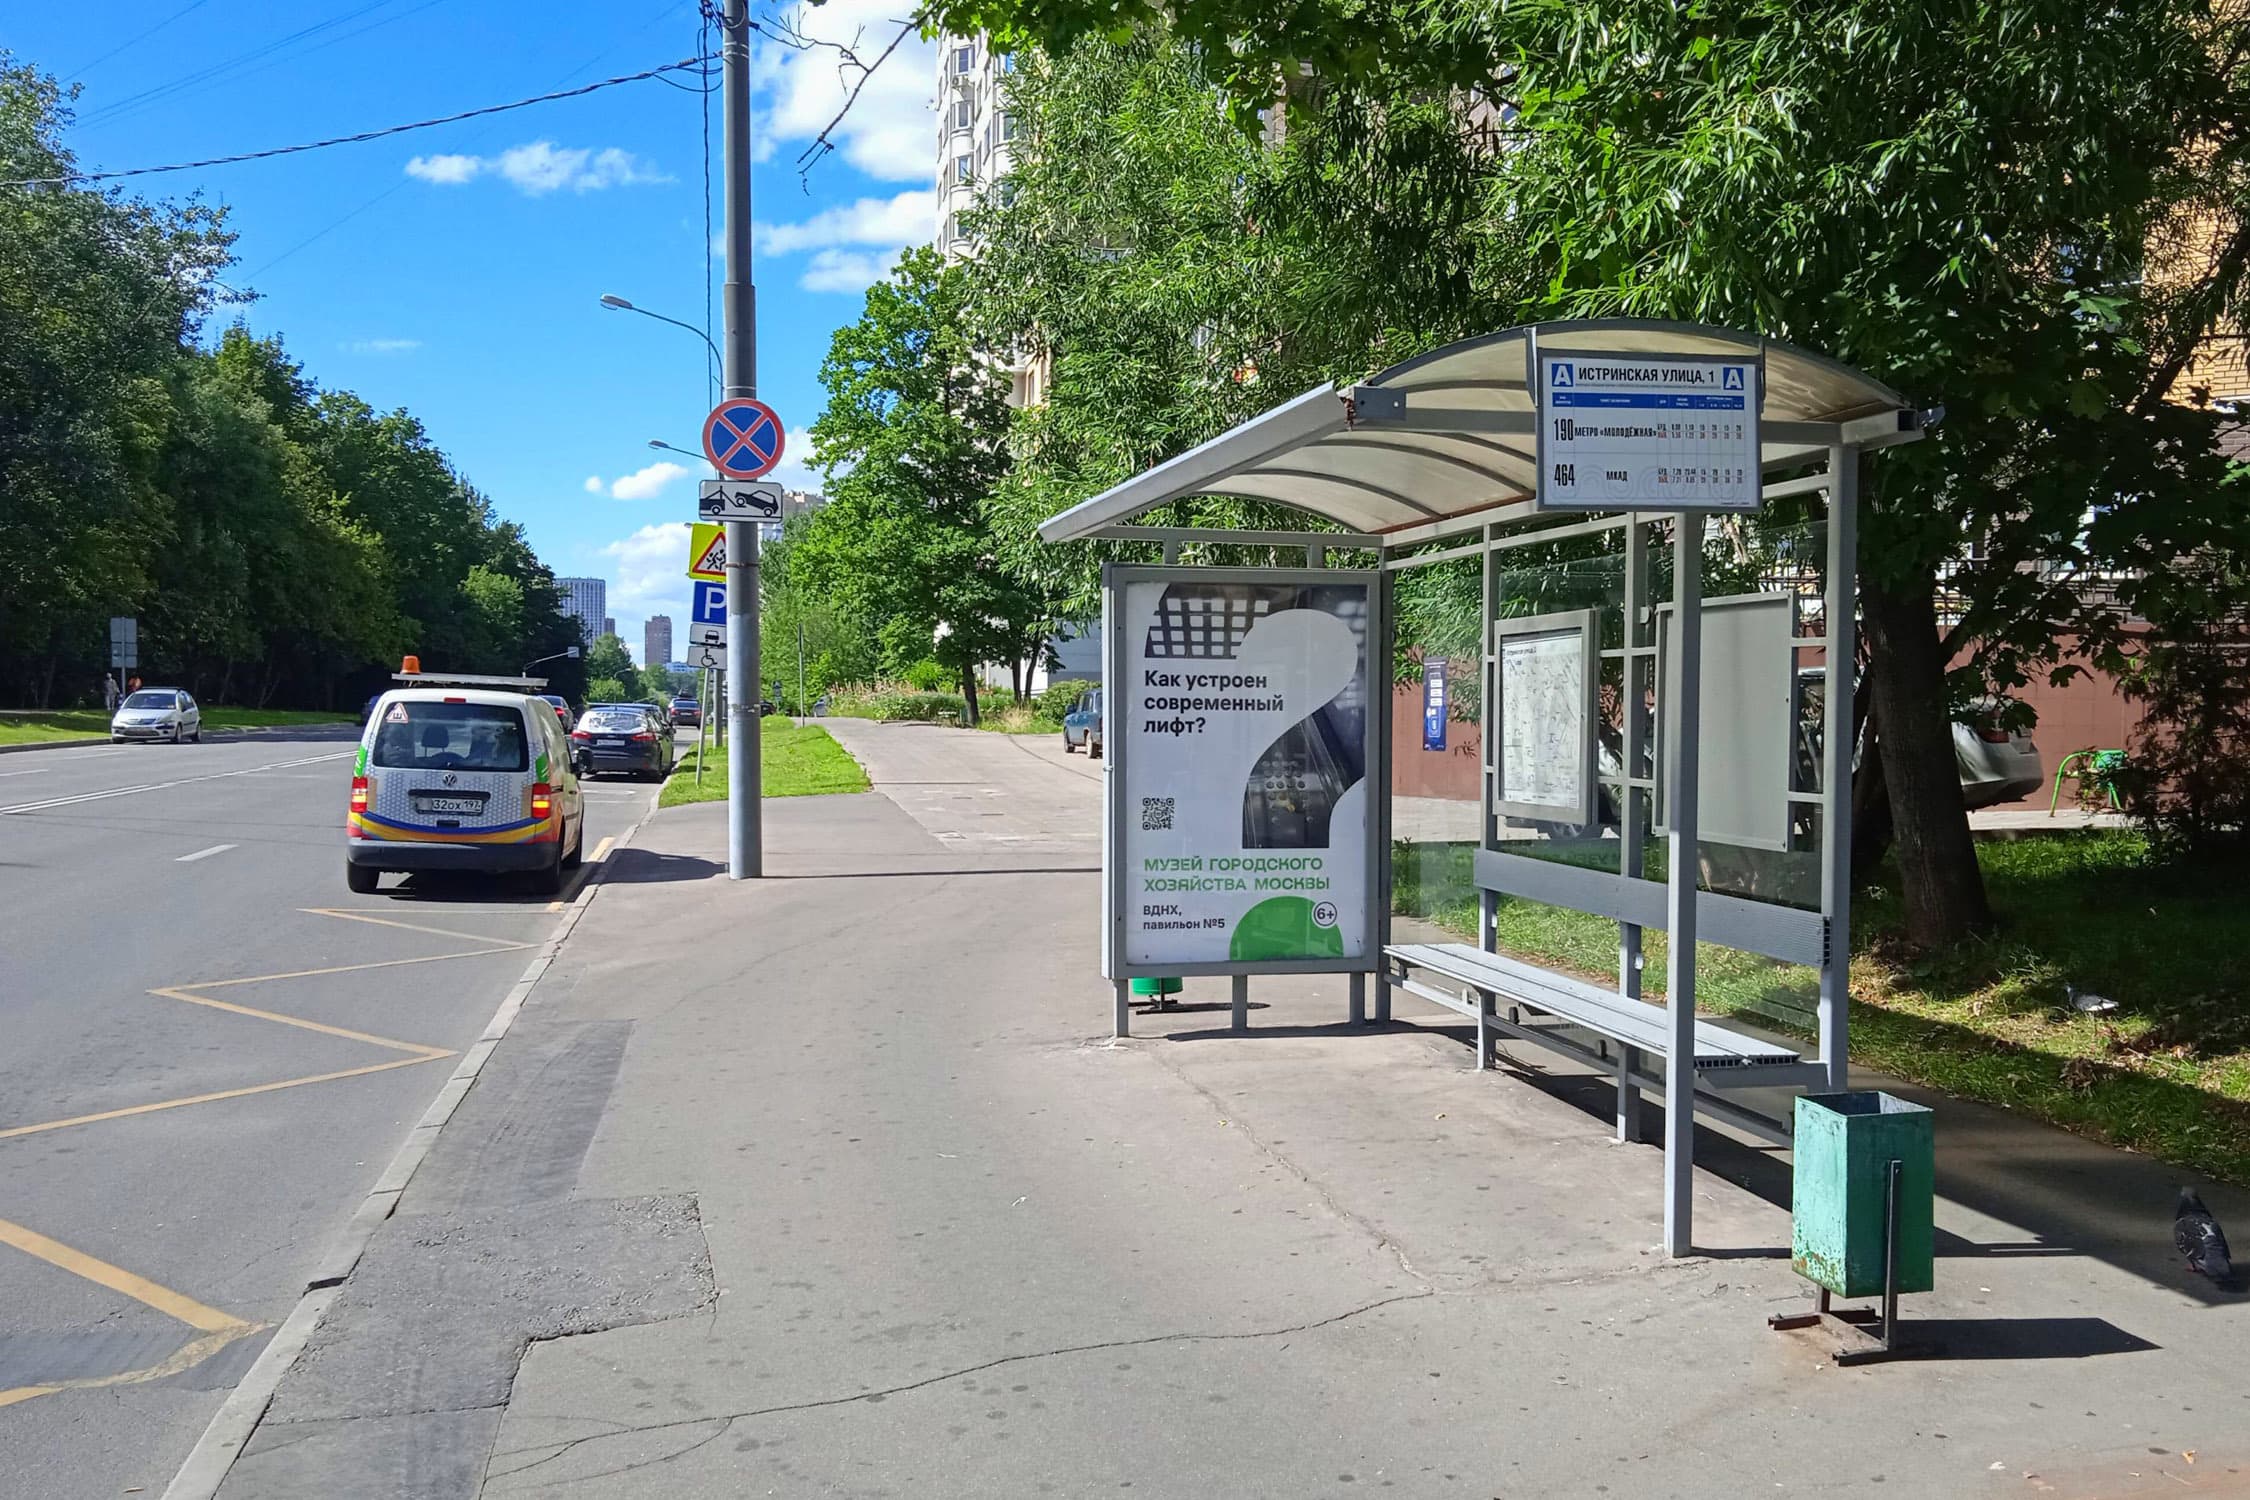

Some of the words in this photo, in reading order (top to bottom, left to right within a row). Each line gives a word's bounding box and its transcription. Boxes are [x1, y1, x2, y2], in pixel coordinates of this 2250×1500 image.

[1578, 367, 1658, 382] ИСТРИНСКАЯ
[1661, 368, 1705, 384] УЛИЦА,
[1708, 370, 1714, 383] 1
[1553, 418, 1574, 441] 190
[1574, 426, 1599, 437] МЕТРО
[1554, 463, 1575, 486] 464
[1606, 470, 1628, 482] МКАД
[1144, 670, 1181, 687] Как
[1186, 674, 1267, 691] устроен
[1144, 694, 1284, 713] современный
[1143, 717, 1206, 736] лифт?
[1144, 855, 1203, 871] МУЗЕЙ
[1209, 857, 1323, 872] ГОРОДСКОГО
[1144, 875, 1247, 892] ХОЗЯЙСТВА
[1254, 877, 1330, 890] МОСКВЫ
[1143, 904, 1182, 916] ВДНХ,
[1316, 907, 1335, 920] 6+
[1143, 919, 1200, 930] павильон
[1202, 918, 1226, 929] №5
